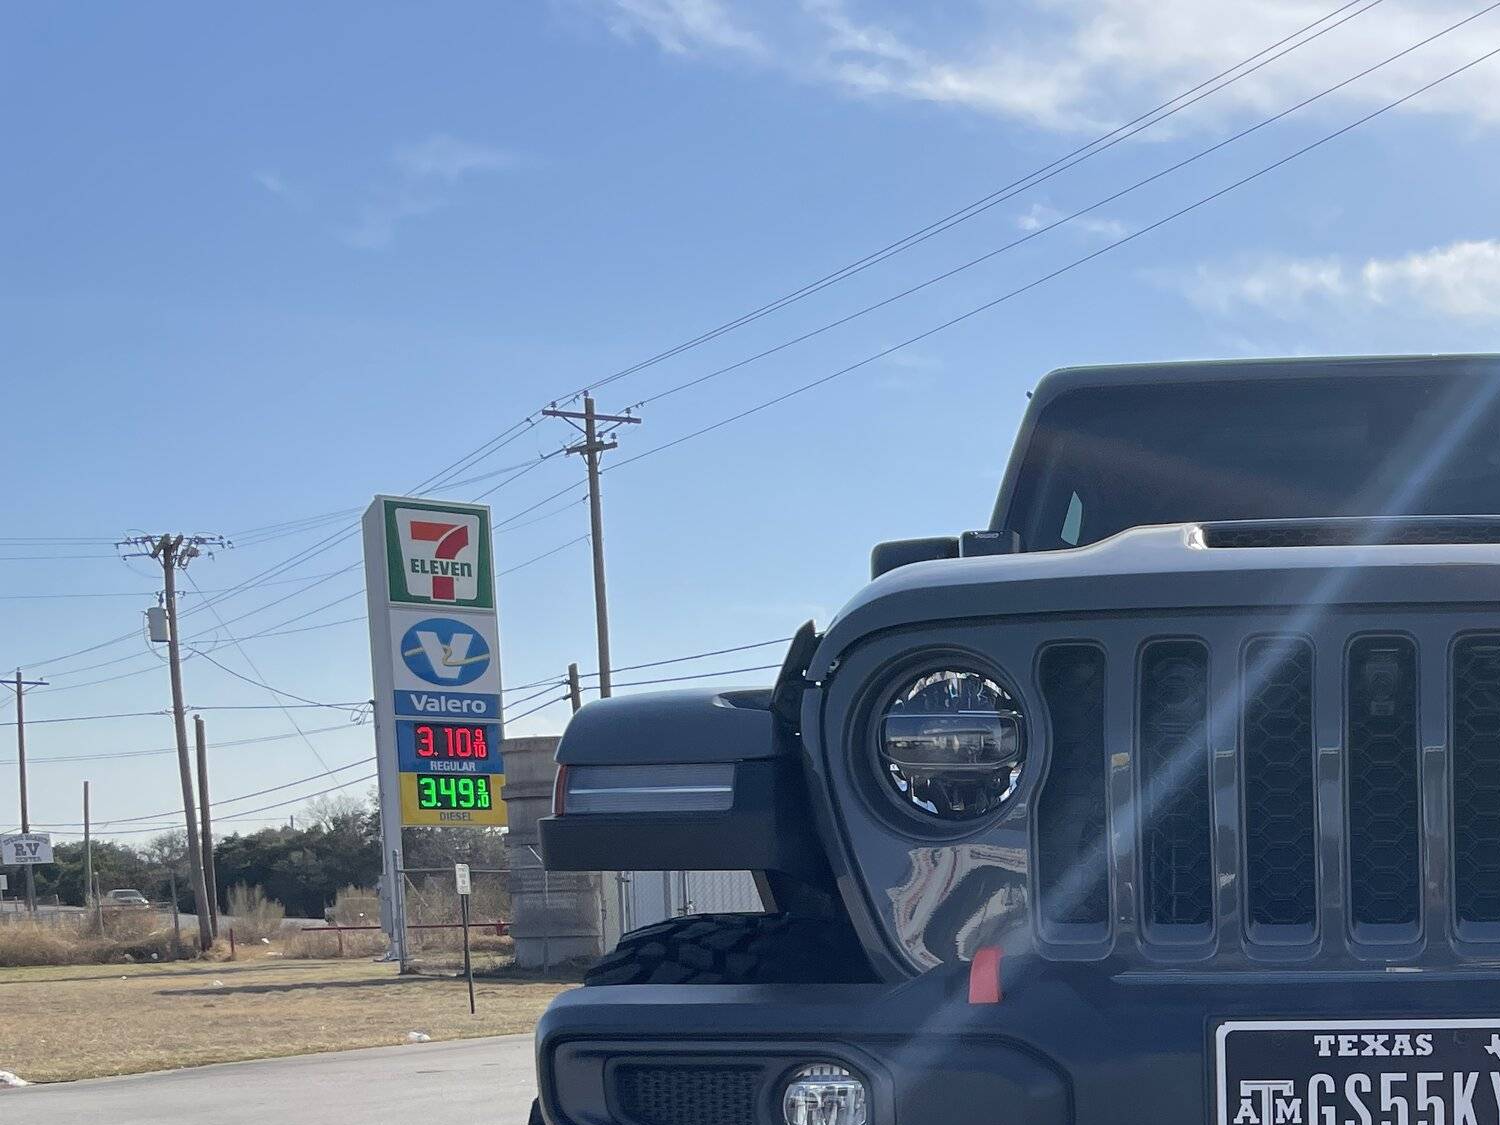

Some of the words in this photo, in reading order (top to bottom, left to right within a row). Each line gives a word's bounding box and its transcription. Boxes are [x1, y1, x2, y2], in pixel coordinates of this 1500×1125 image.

[410, 521, 469, 599] 7
[410, 694, 487, 713] Valero
[430, 761, 476, 772] REGULAR
[440, 812, 472, 821] DIESEL
[14, 842, 40, 856] RV
[1313, 1033, 1433, 1057] TEXAS
